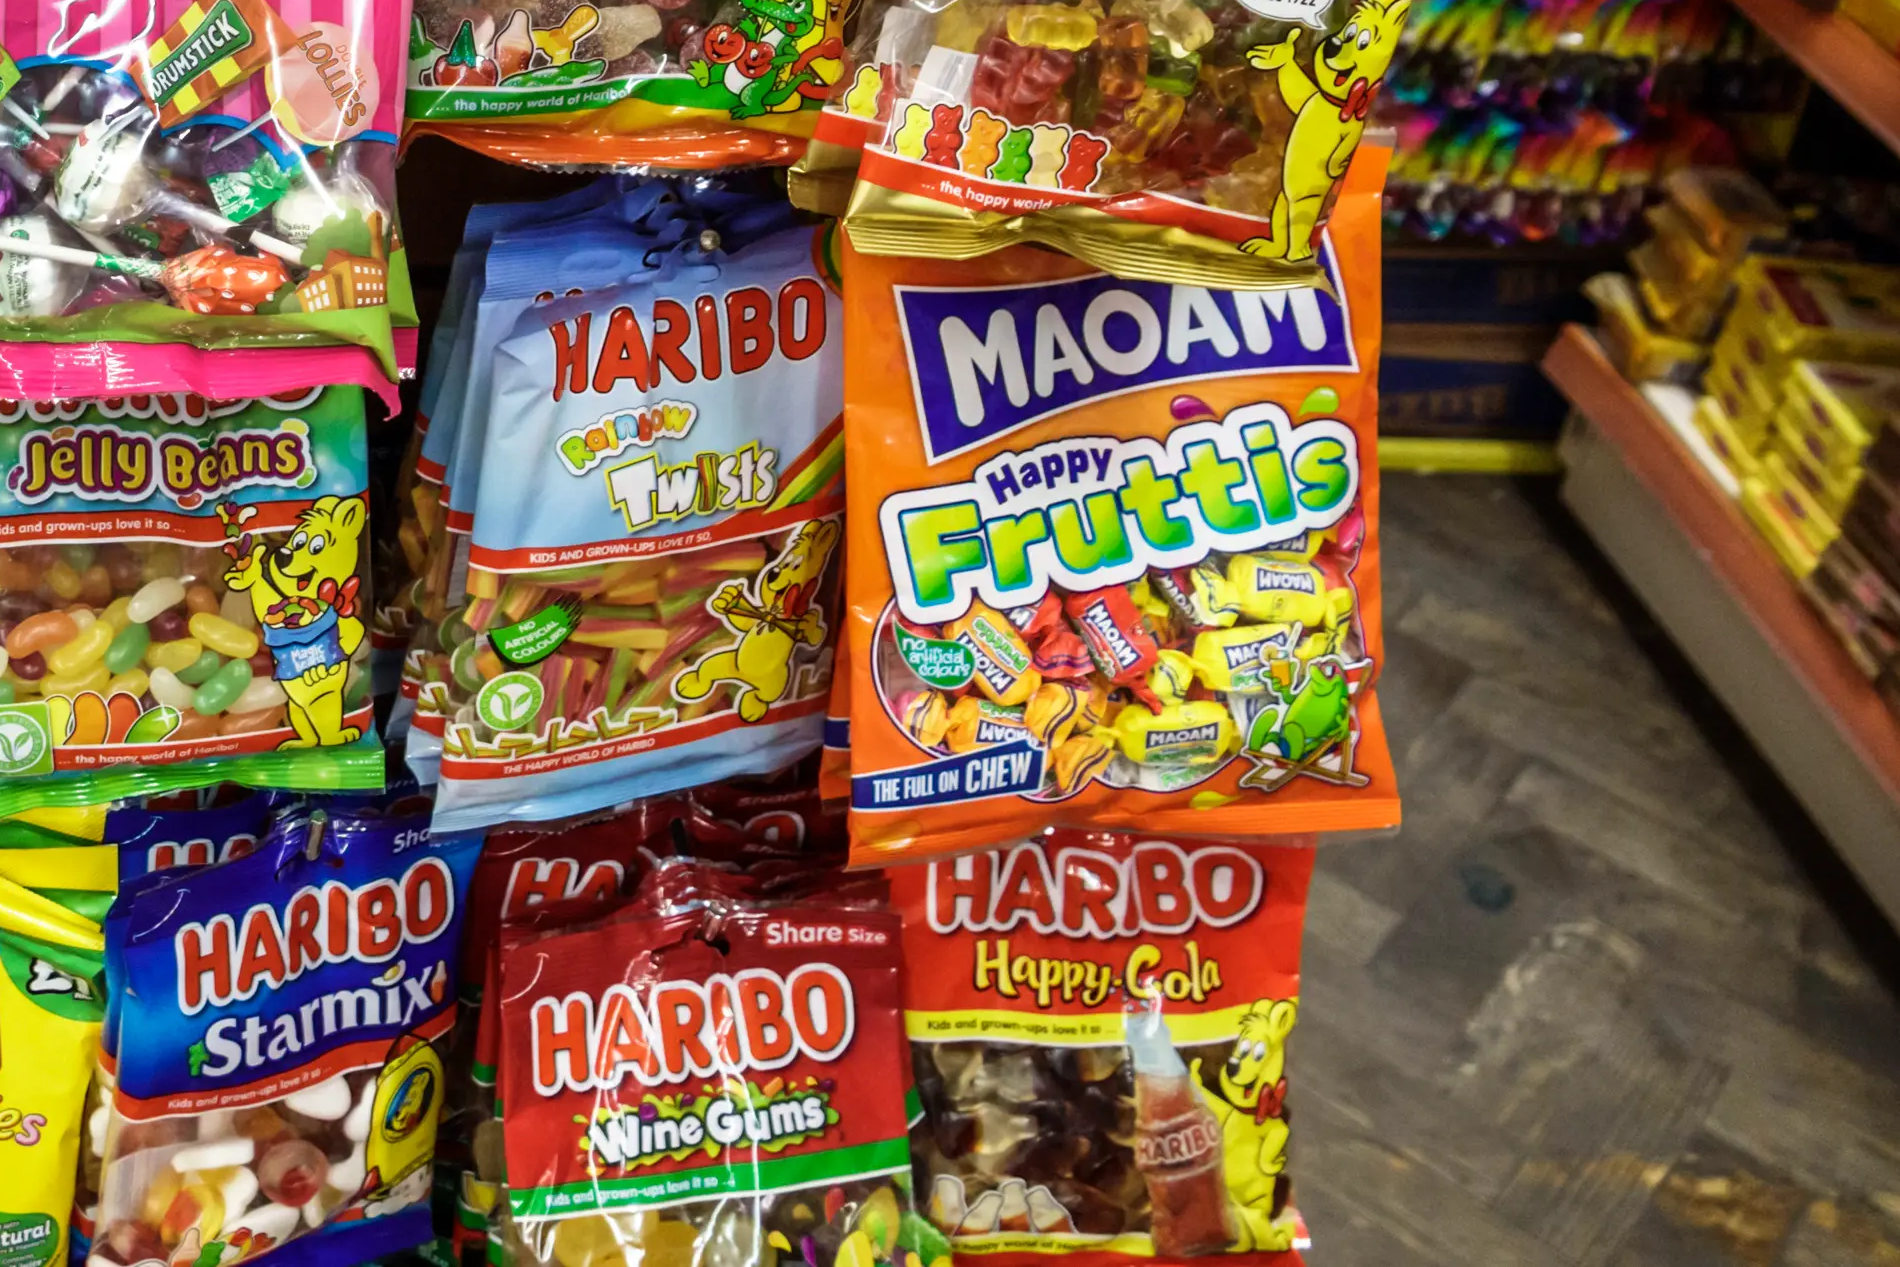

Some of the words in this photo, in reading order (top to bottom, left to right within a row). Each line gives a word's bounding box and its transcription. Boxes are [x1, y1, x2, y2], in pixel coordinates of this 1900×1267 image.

[149, 16, 239, 99] DRUMSTICK
[298, 29, 367, 127] LOLLIES
[939, 180, 962, 198] the
[965, 187, 1009, 210] happy
[549, 276, 828, 402] HARIBO
[938, 286, 1330, 428] MAOAM
[21, 434, 149, 496] Jelly
[163, 433, 302, 491] Beans
[559, 402, 695, 473] Rainbow
[607, 441, 779, 531] Twists
[986, 447, 1113, 506] Happy
[16, 521, 43, 535] and
[45, 520, 113, 536] grown-ups
[115, 518, 141, 531] love
[145, 518, 153, 530] it
[156, 519, 171, 531] so
[898, 418, 1352, 610] Fruttis
[503, 620, 560, 651] ARTIFICIAL
[901, 636, 927, 652] no
[908, 648, 967, 665] artificial
[918, 661, 971, 678] colours
[1087, 602, 1143, 672] MAOAM
[1149, 726, 1216, 746] MAOAM
[873, 778, 901, 803] THE
[903, 772, 935, 797] FULL
[938, 770, 960, 791] ON
[965, 752, 1033, 793] CHEW
[176, 856, 455, 1015] HARIBO
[765, 922, 843, 945] Share
[848, 928, 887, 945] Size
[974, 938, 1223, 1007] Happy-Cola
[201, 965, 434, 1078] Starmix
[531, 962, 854, 1097] HARIBO
[590, 1111, 702, 1165] Wine
[706, 1095, 826, 1144] Gums
